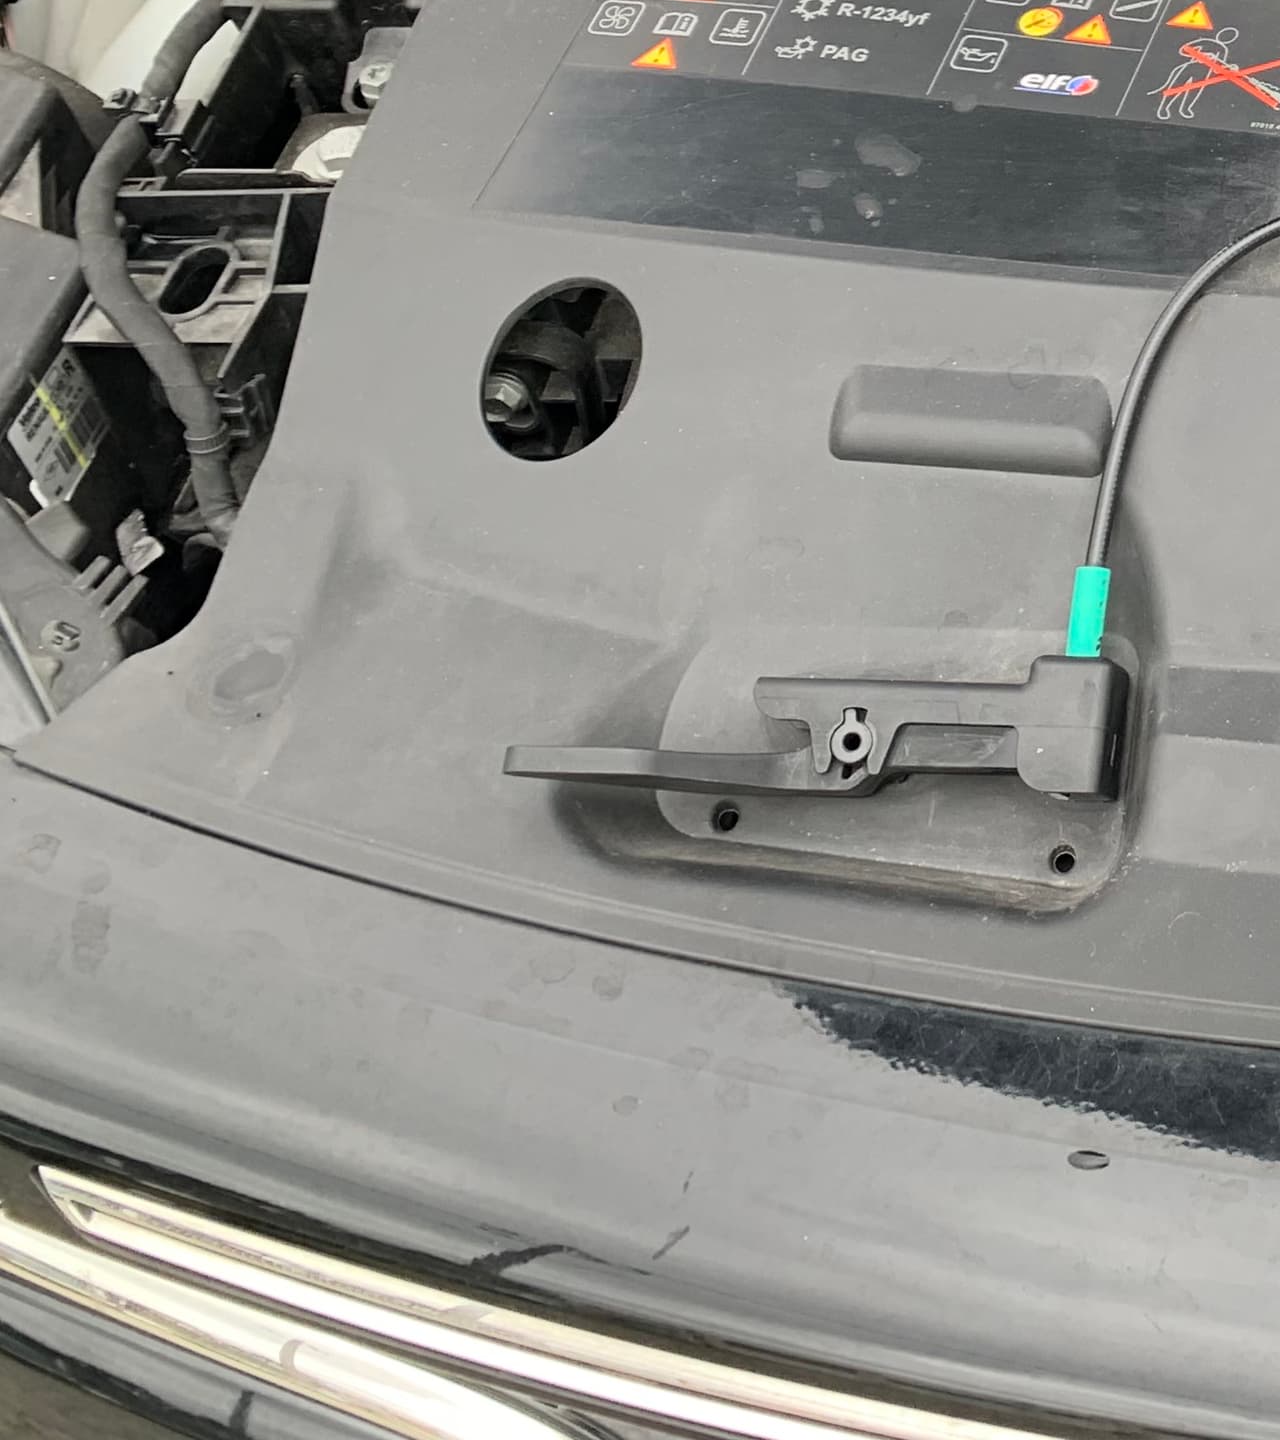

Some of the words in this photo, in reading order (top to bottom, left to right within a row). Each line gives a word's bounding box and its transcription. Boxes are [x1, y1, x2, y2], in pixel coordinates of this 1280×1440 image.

[837, 2, 931, 27] R-1234yf
[819, 44, 870, 62] PAG
[1019, 73, 1072, 90] elf
